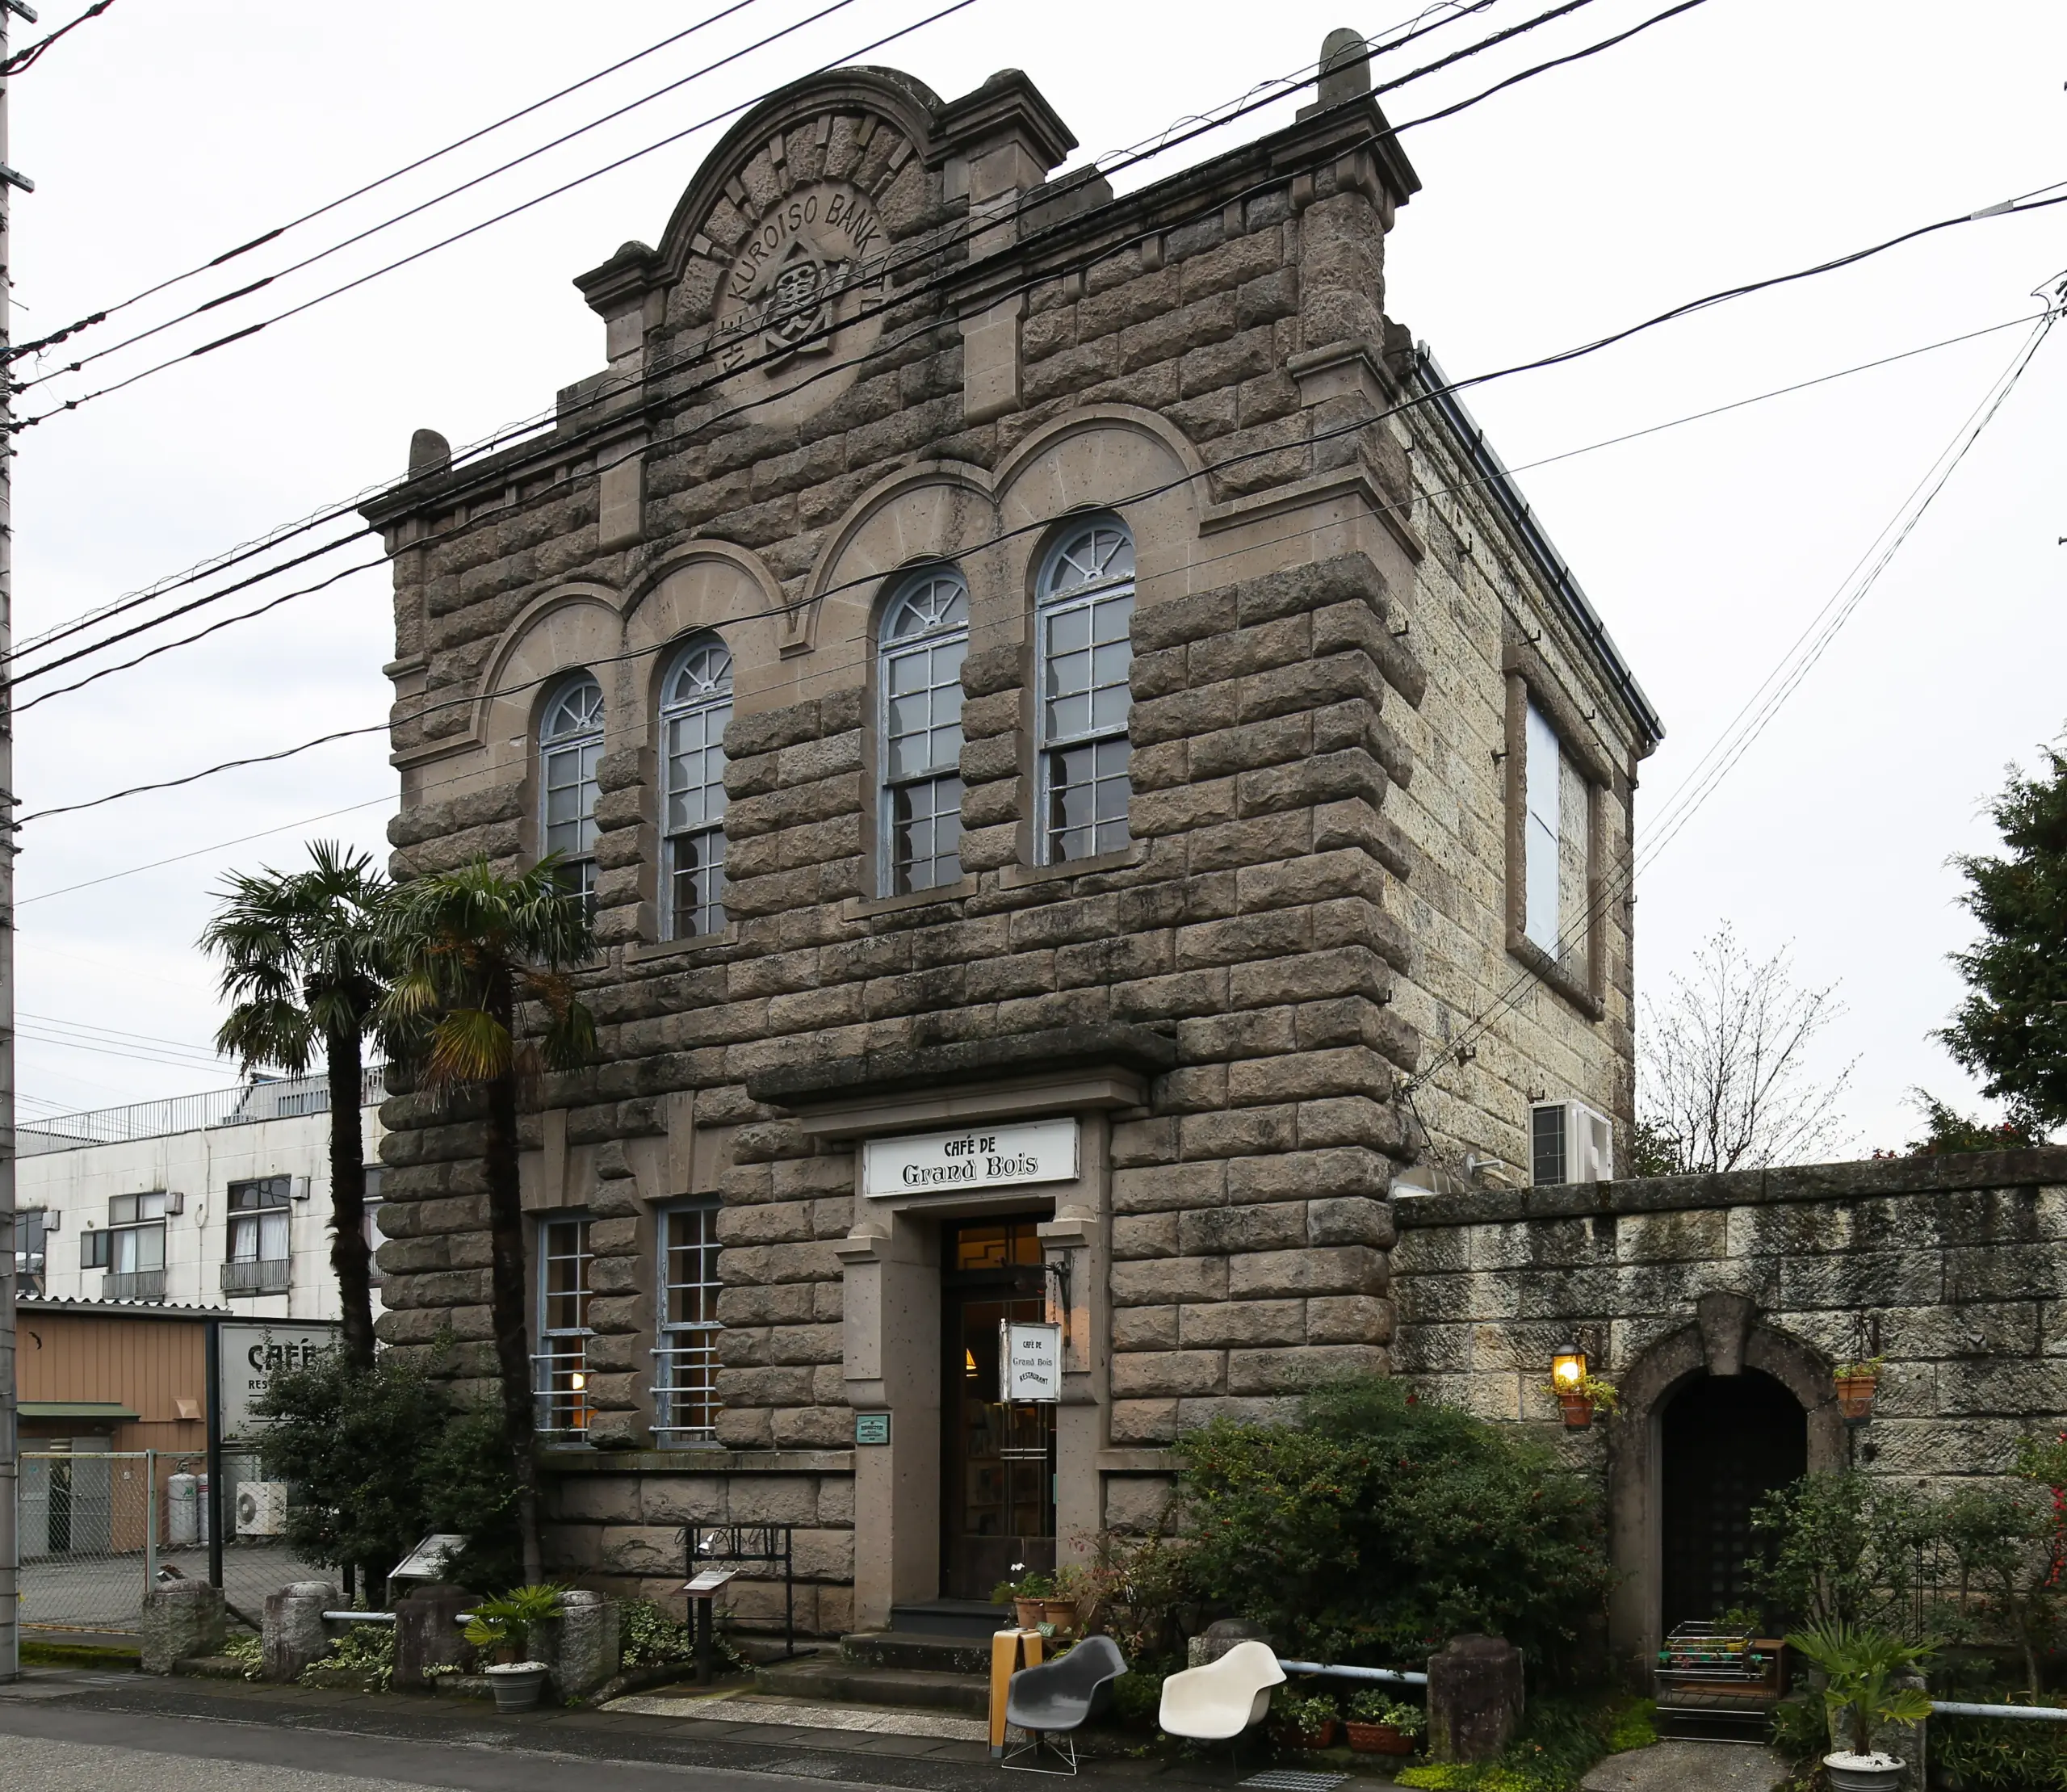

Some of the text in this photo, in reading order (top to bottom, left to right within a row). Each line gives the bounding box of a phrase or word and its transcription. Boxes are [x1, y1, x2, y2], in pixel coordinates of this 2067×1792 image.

[727, 195, 818, 300] KUROISO
[825, 193, 881, 255] BANK
[944, 1134, 996, 1157] CAFÉ DE
[903, 1152, 1038, 1187] Grand Bois
[1022, 1339, 1042, 1349] CAFÉ DE
[1013, 1357, 1053, 1366] Grand Bois
[1019, 1371, 1049, 1385] RESTAURANT
